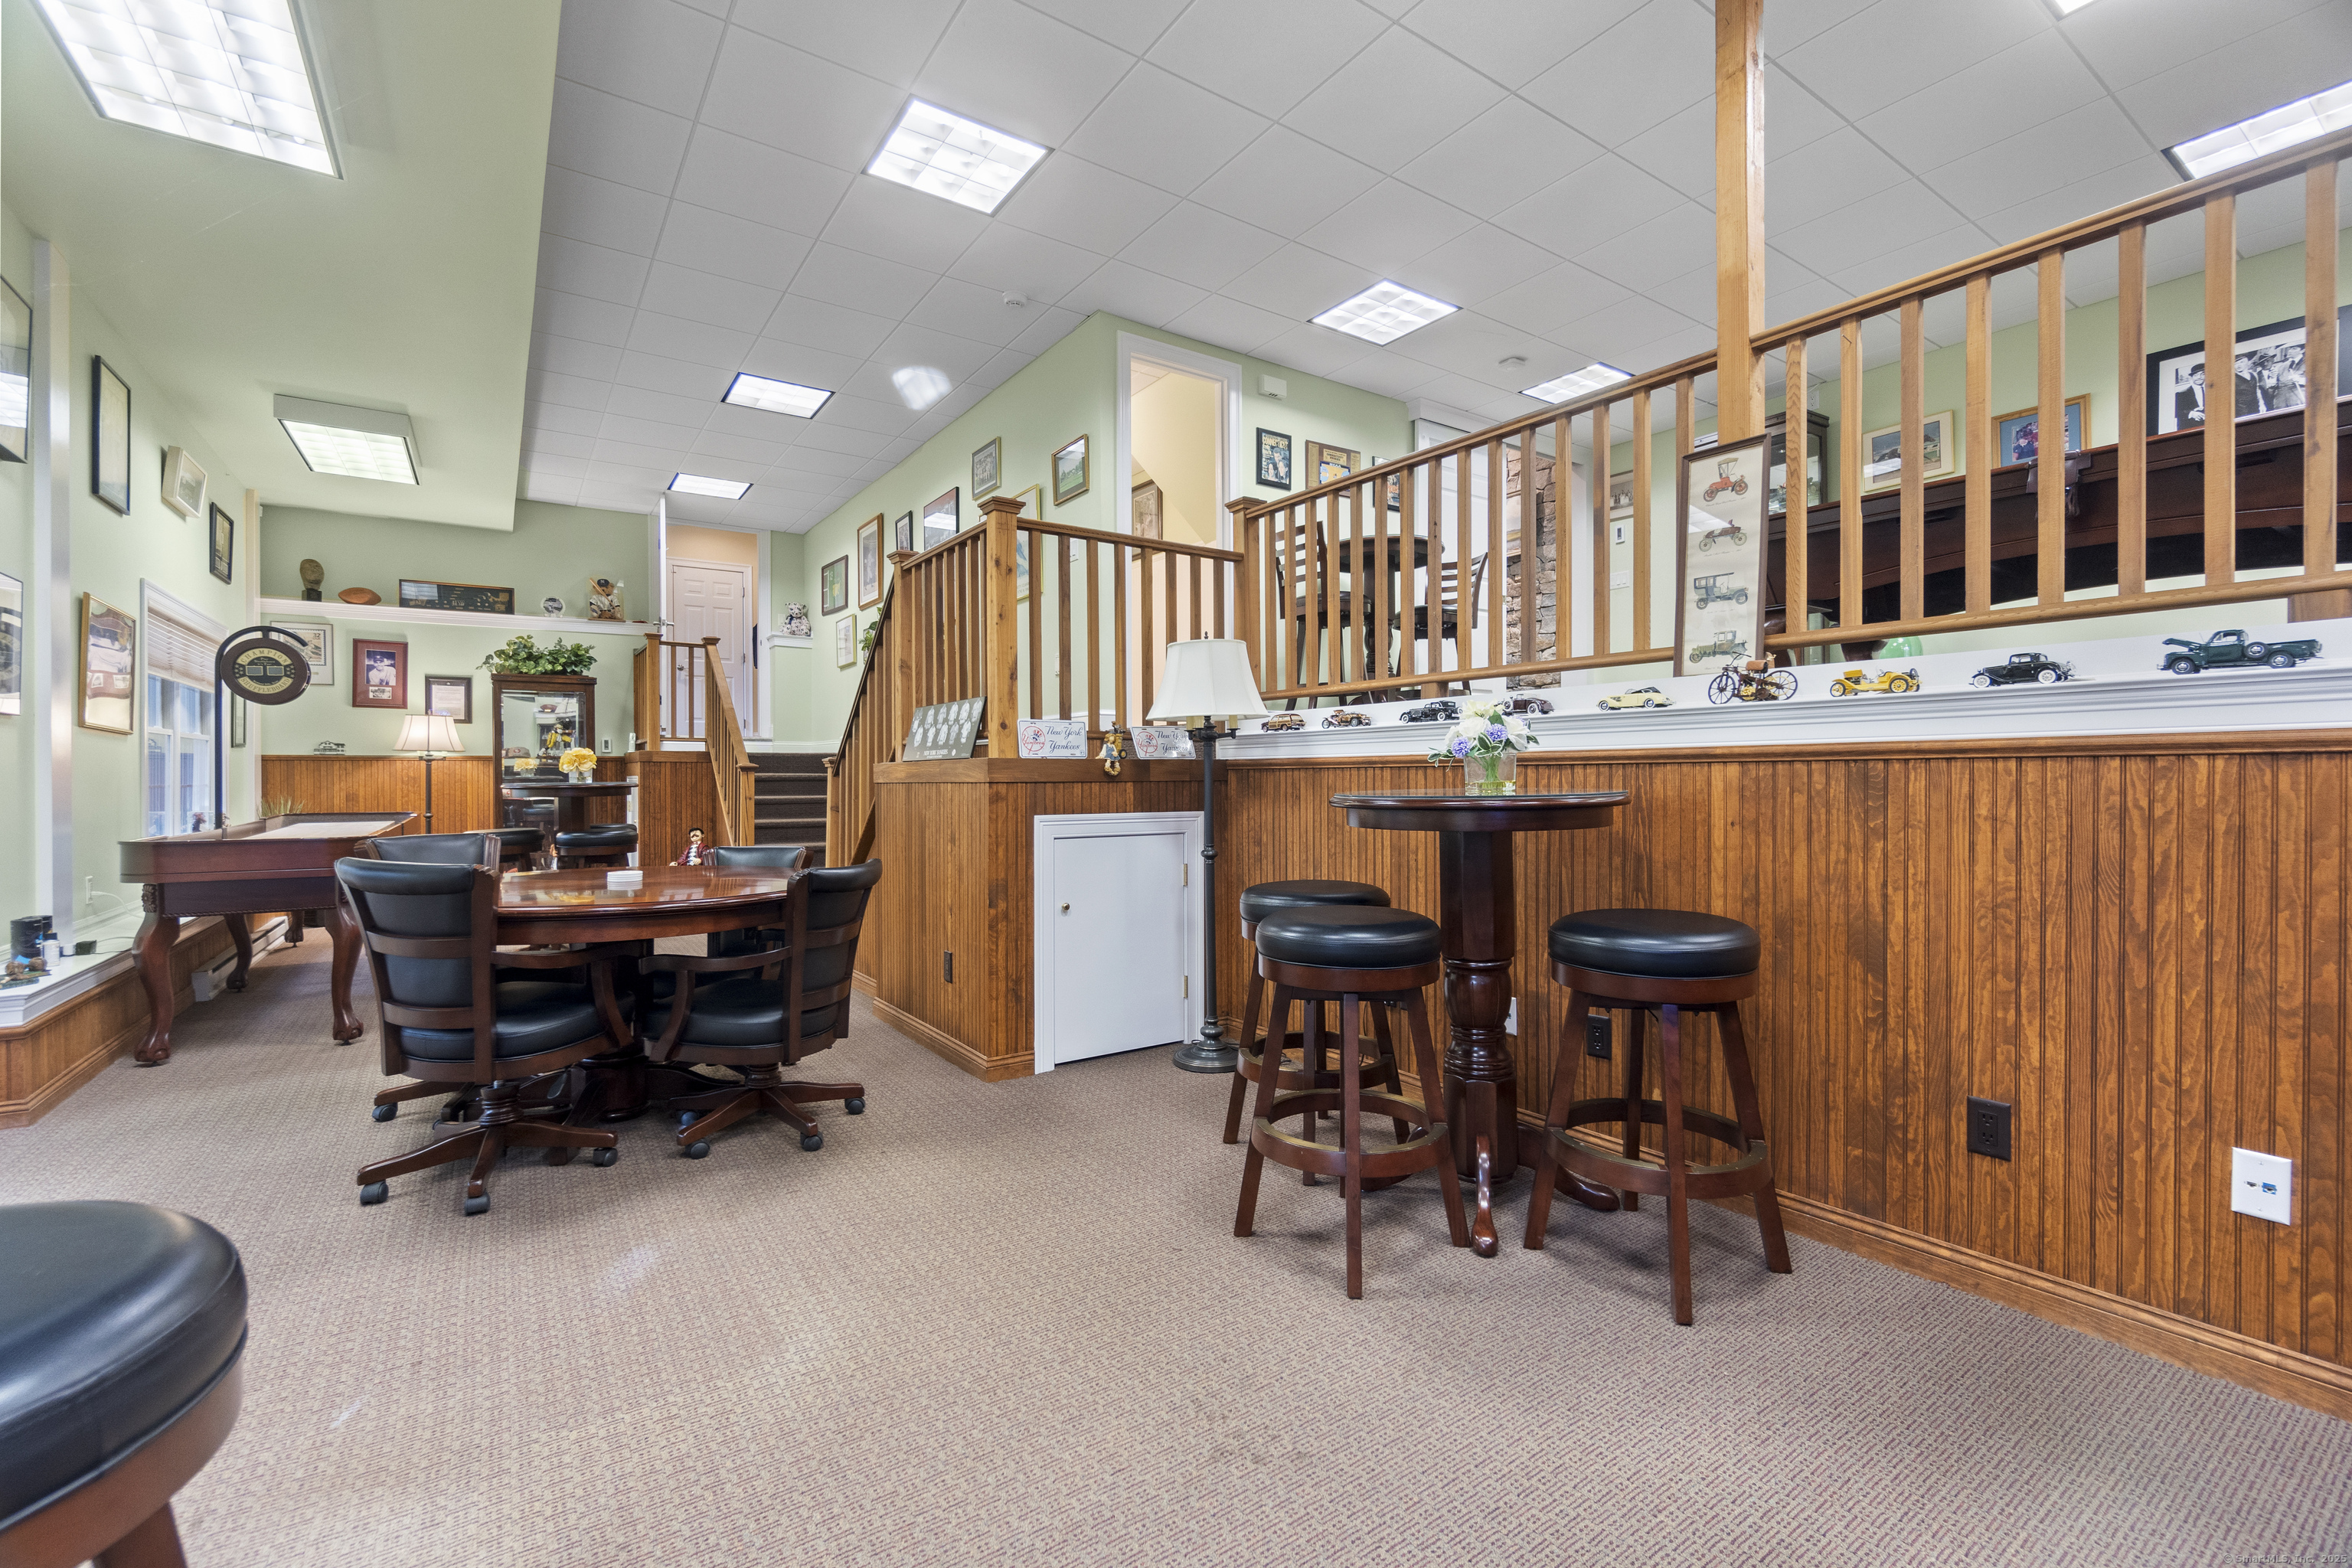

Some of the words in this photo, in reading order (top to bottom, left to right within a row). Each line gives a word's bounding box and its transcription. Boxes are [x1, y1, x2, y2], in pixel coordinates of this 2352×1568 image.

[240, 649, 289, 664] CHAMPION
[240, 678, 290, 693] SHUFFLEBOARD
[1044, 725, 1063, 736] New
[1063, 726, 1083, 740] York
[1155, 730, 1171, 739] New
[1048, 740, 1081, 754] Yankees
